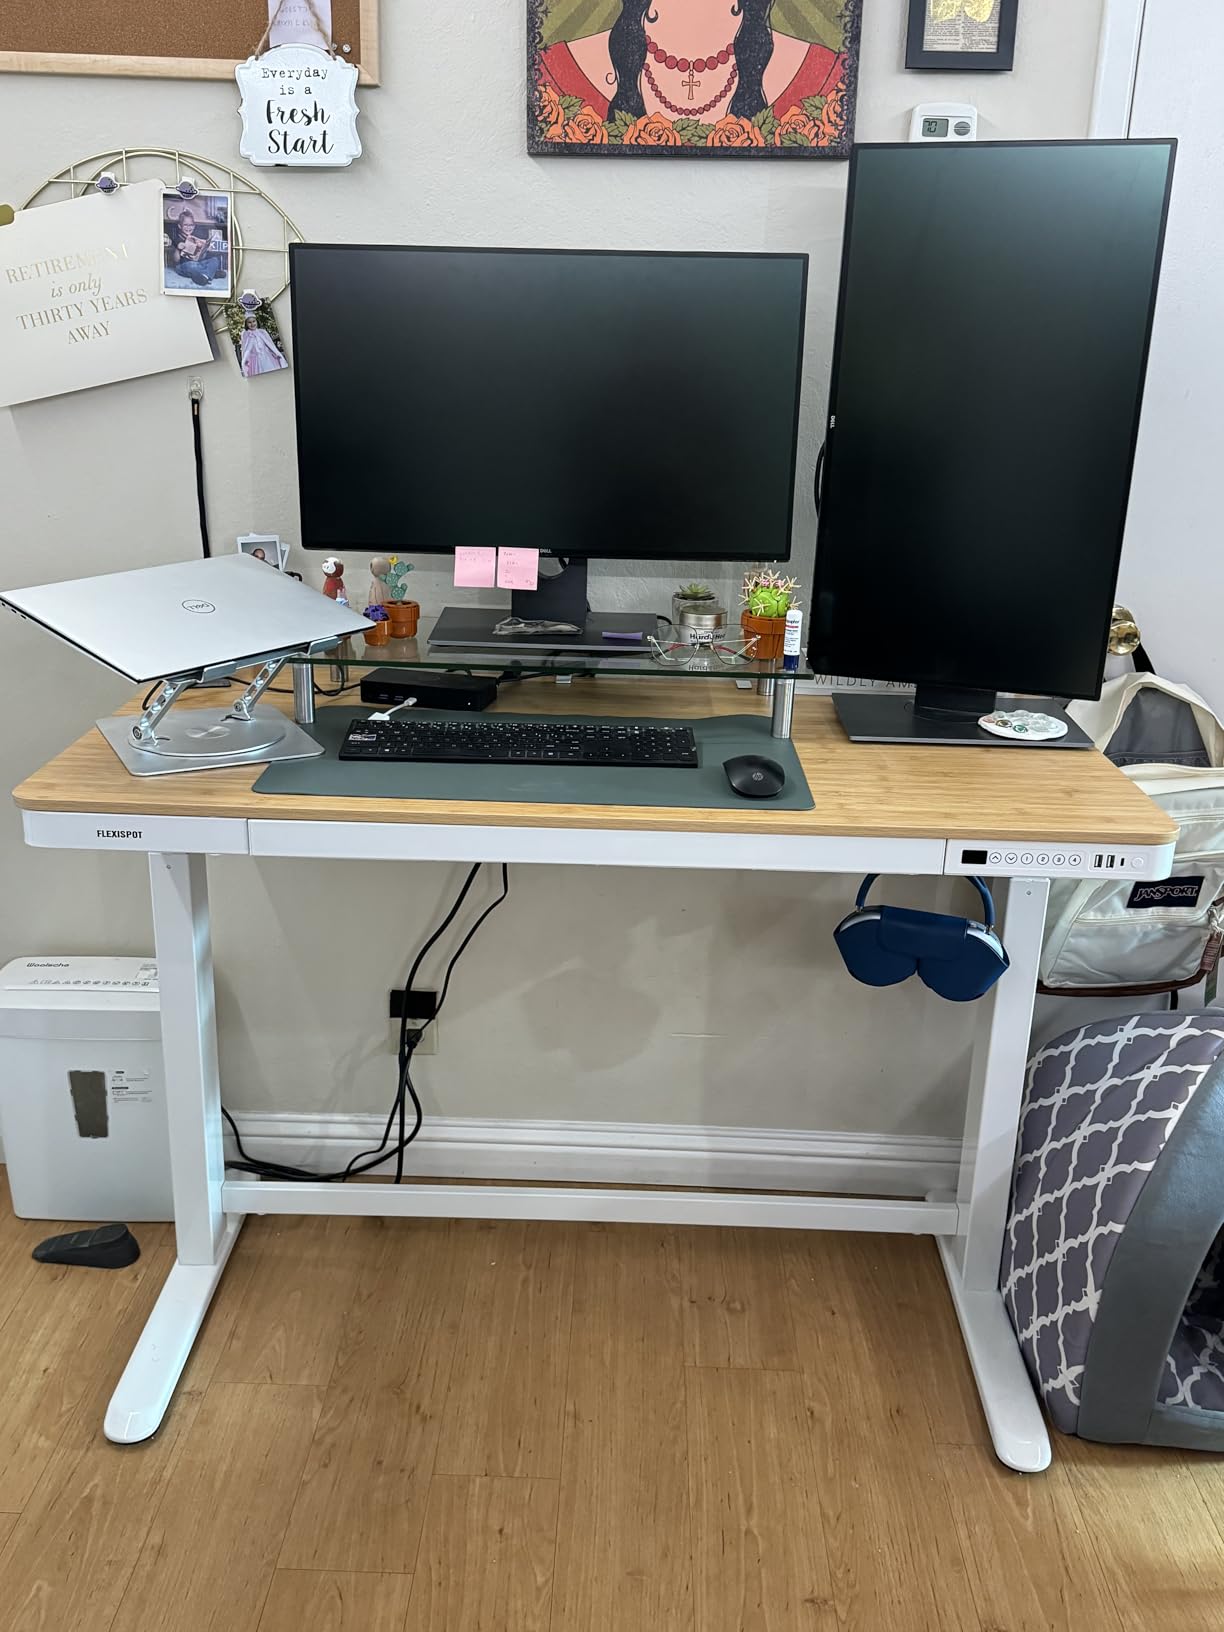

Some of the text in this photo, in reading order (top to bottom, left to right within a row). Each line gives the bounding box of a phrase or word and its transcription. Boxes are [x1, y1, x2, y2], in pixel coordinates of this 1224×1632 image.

[261, 67, 328, 80] Everyday
[279, 85, 312, 95] is a
[266, 100, 331, 126] Fresh
[923, 120, 938, 133] 70
[268, 129, 335, 155] Start
[6, 243, 129, 284] RETIREMNT
[51, 273, 102, 298] is only
[16, 288, 148, 330] THIRTY YEARS
[67, 321, 111, 345] AWAY
[96, 829, 143, 839] FLEXISPOT
[1133, 886, 1199, 901] JANSPORT
